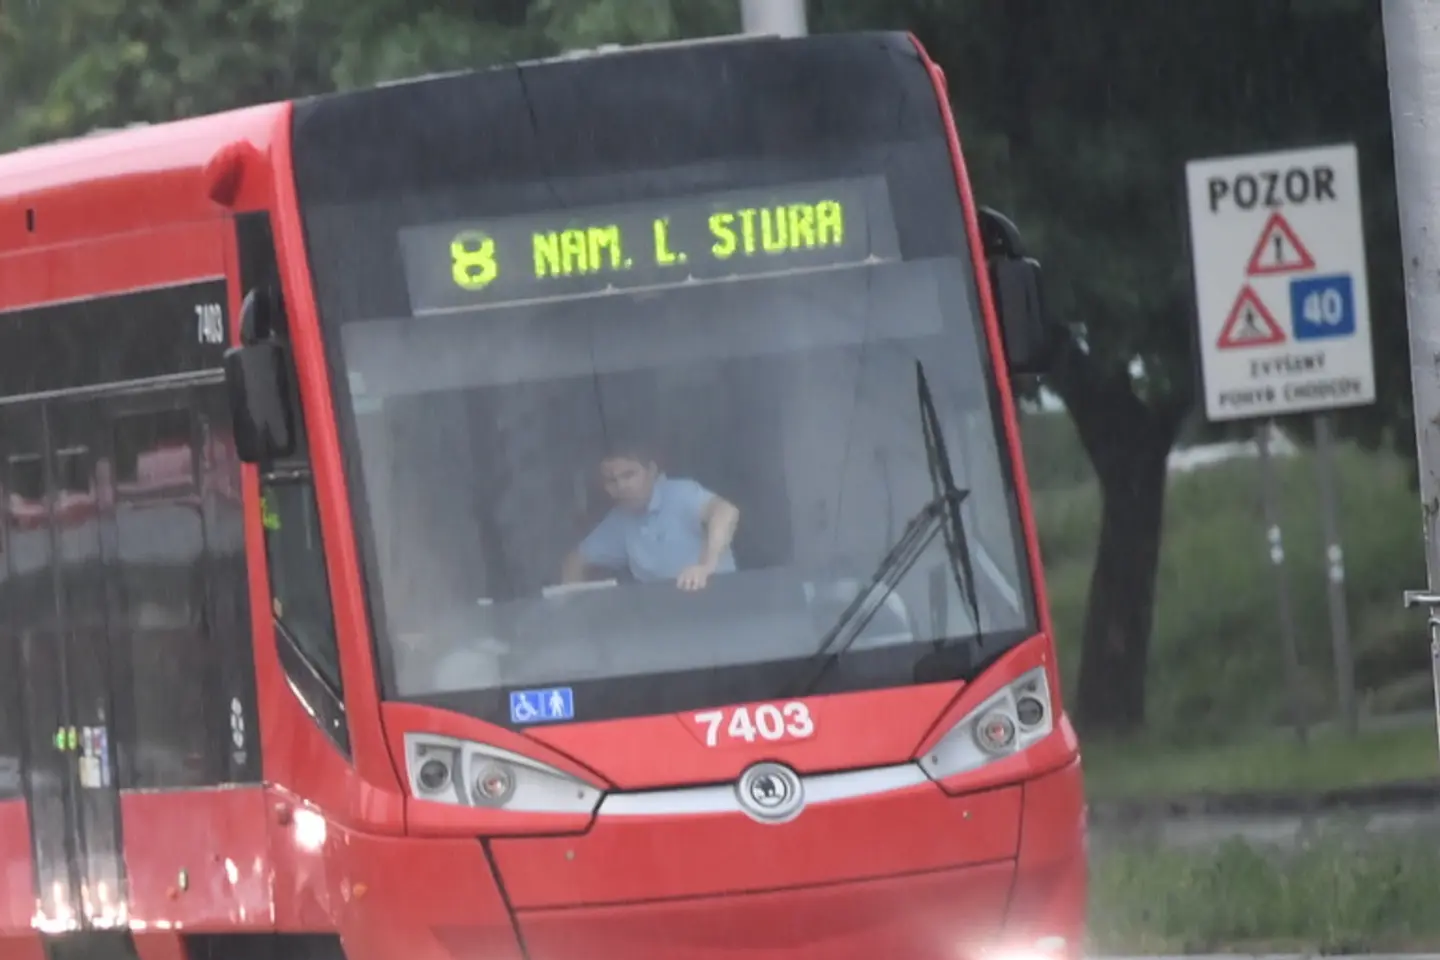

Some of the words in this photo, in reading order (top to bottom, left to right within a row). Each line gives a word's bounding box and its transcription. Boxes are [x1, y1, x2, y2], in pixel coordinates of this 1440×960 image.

[1207, 165, 1336, 214] POZOR
[449, 230, 500, 291] 8
[1302, 286, 1344, 327] 40
[694, 701, 815, 748] 7403
